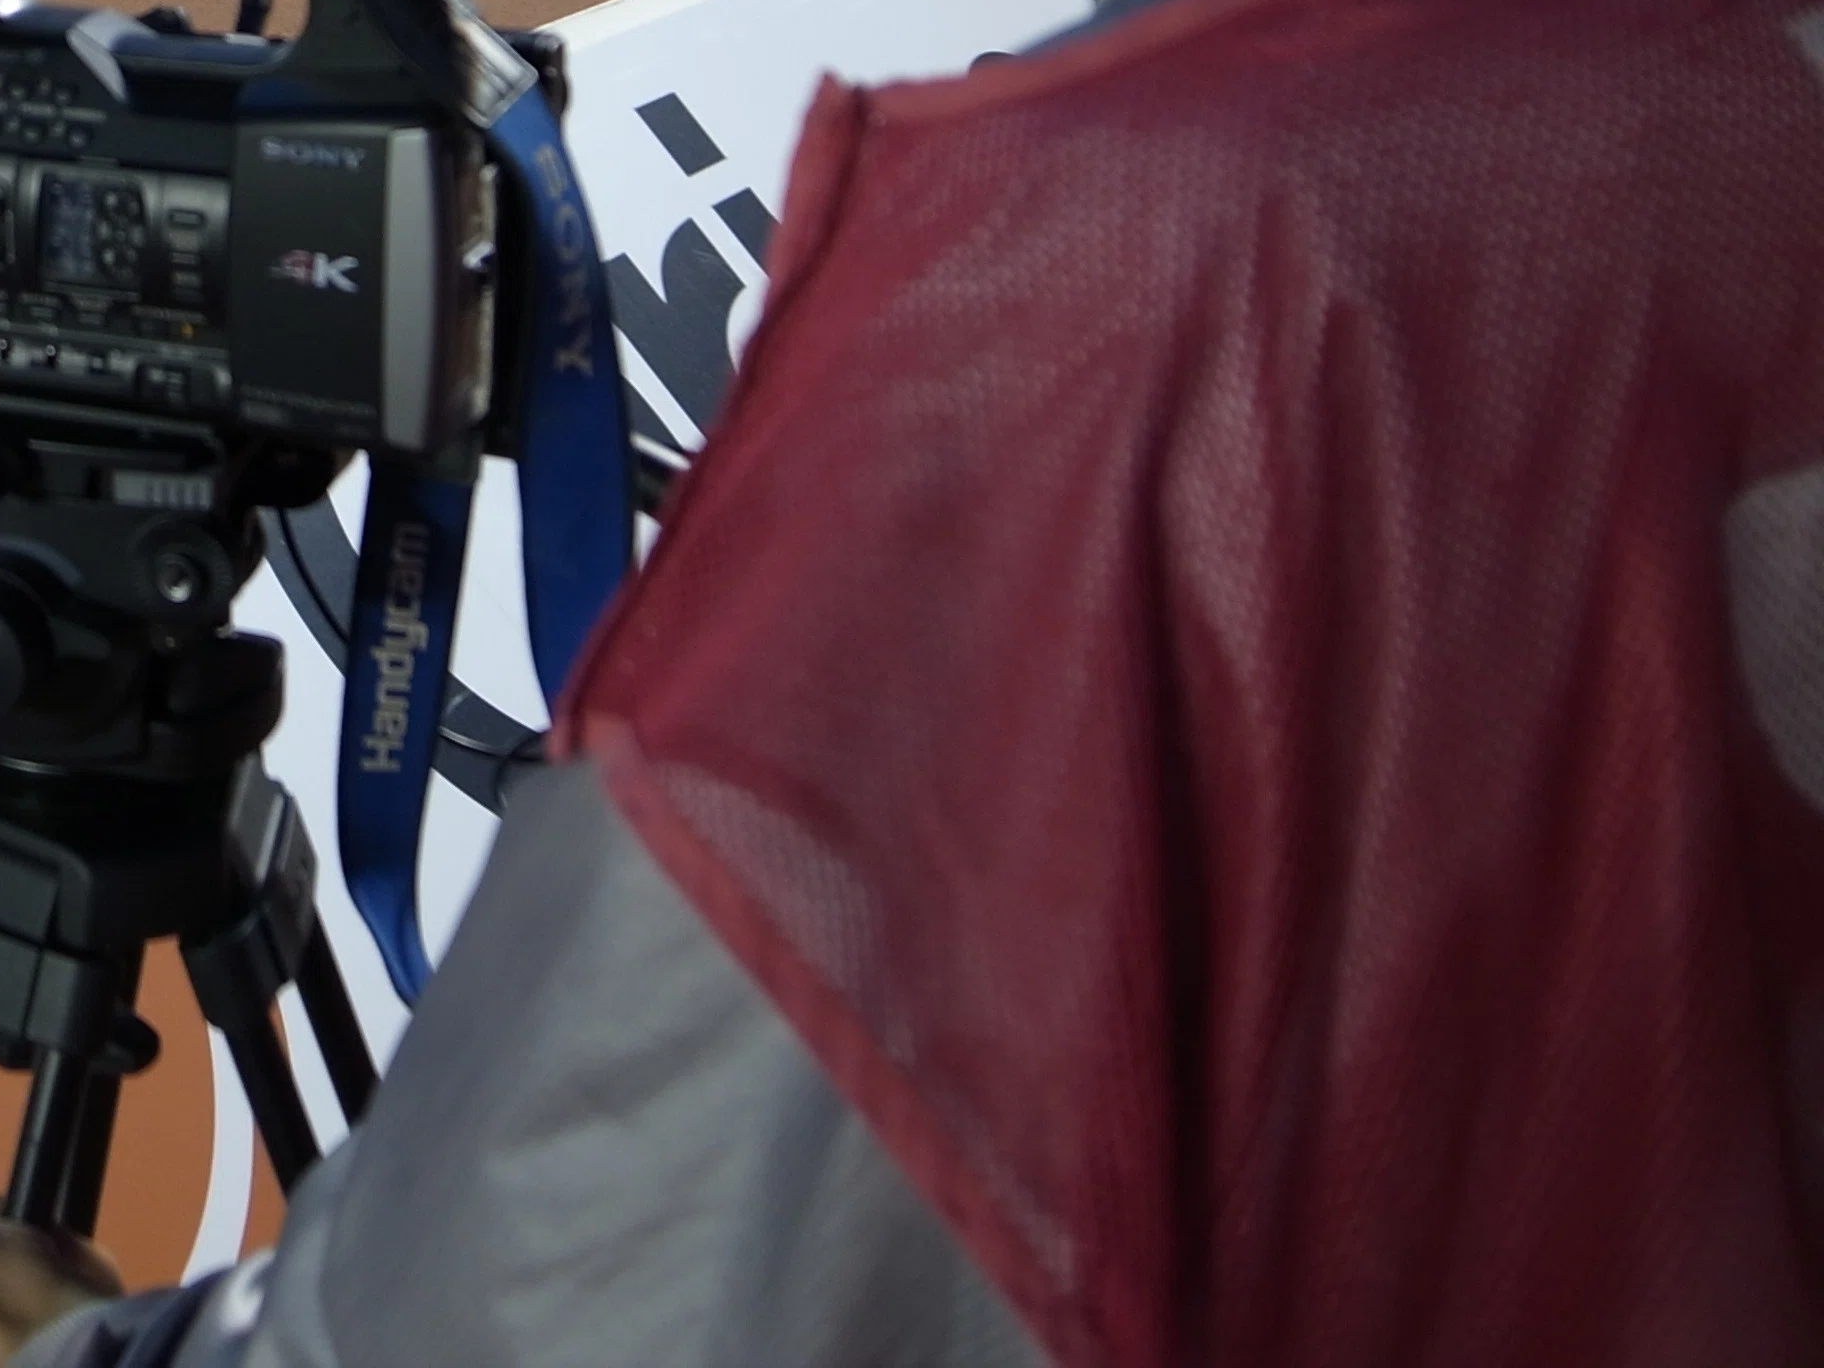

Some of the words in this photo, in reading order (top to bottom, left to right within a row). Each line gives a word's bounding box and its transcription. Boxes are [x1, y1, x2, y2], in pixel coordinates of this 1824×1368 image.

[259, 135, 367, 170] SONY
[532, 143, 595, 378] SONY
[359, 522, 429, 773] Handycam
